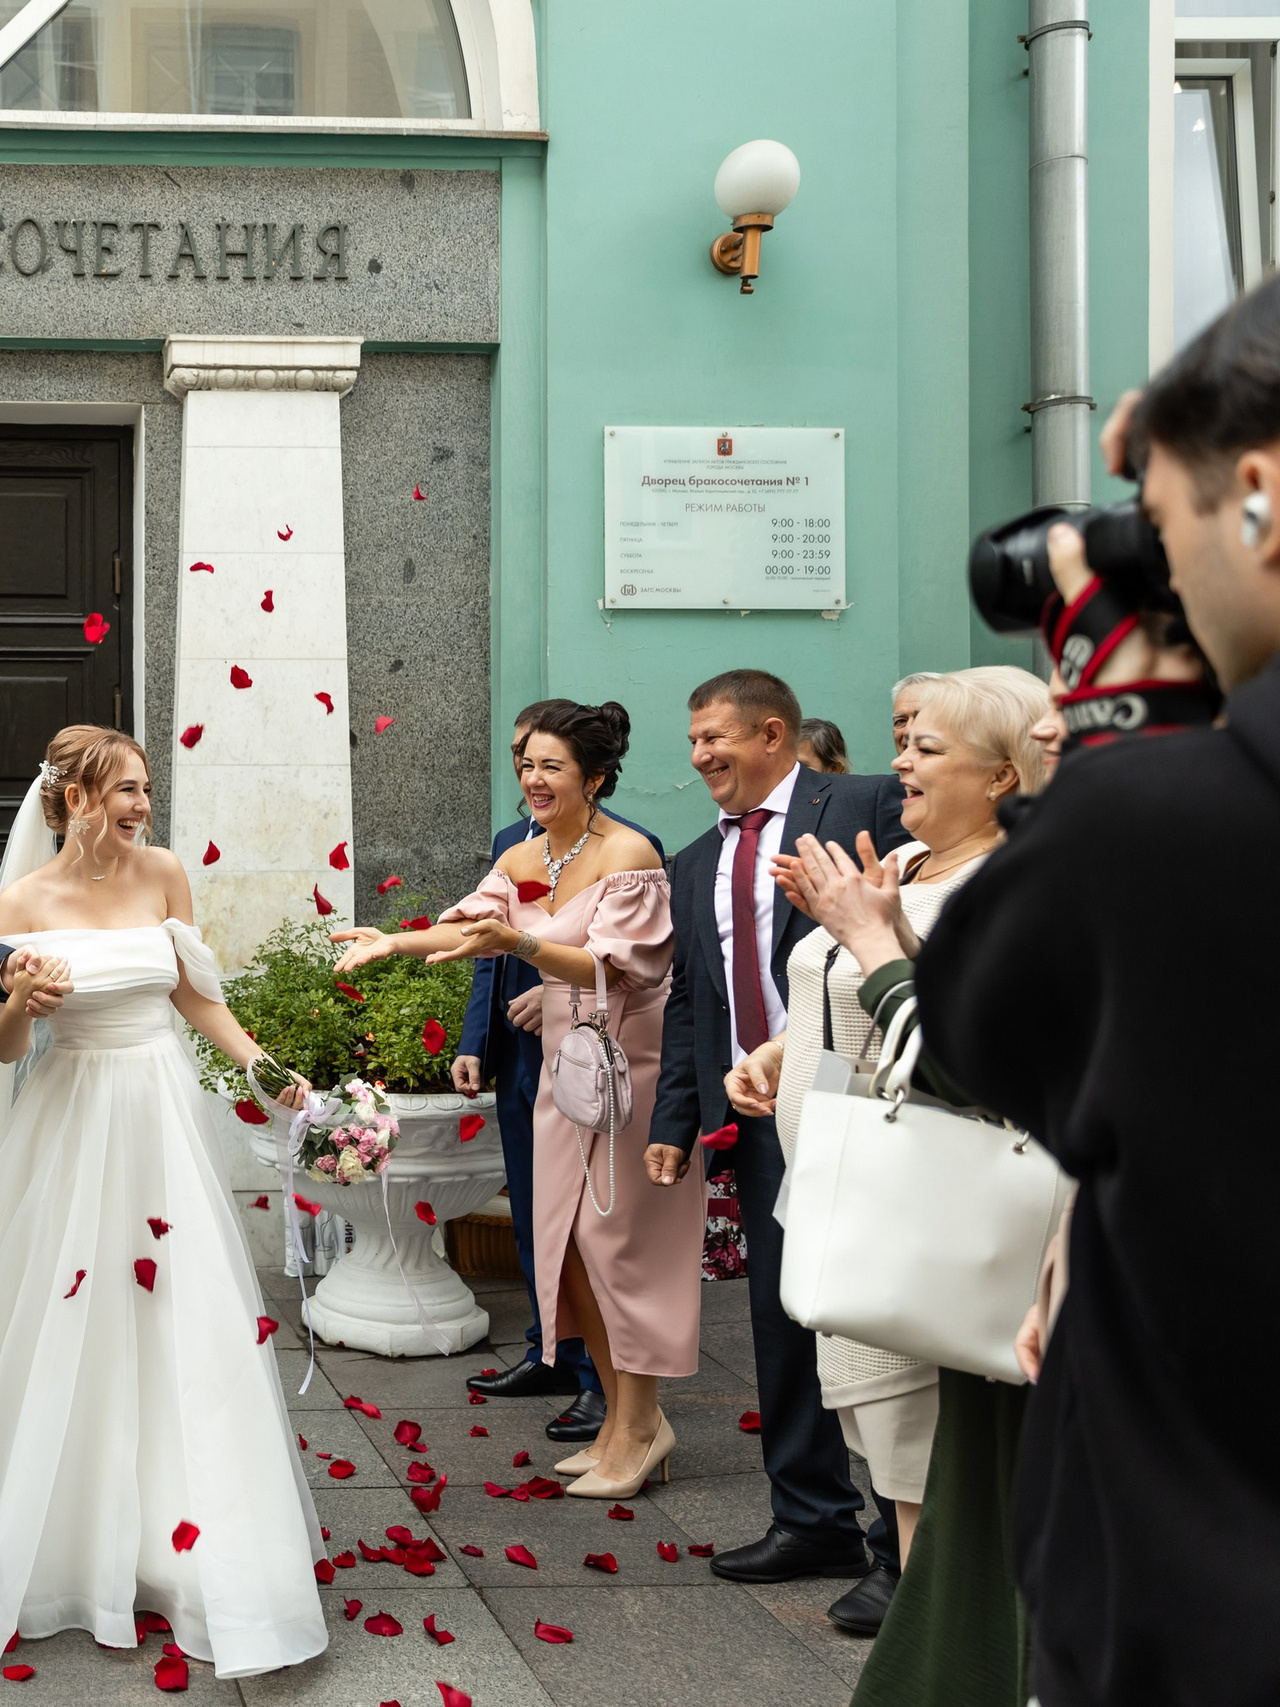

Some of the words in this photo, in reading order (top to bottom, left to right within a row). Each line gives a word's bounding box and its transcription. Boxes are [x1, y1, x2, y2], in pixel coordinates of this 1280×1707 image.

[641, 475, 686, 488] Дворец
[688, 475, 783, 488] бракосочетания
[786, 476, 800, 486] №
[804, 476, 809, 486] 1
[685, 503, 723, 513] РЕЖИМ
[726, 503, 766, 513] РАБОТЫ
[771, 518, 794, 528] 9:00
[804, 518, 831, 528] 18:00
[771, 534, 794, 543] 9:00
[802, 534, 831, 543] 20:00
[771, 549, 794, 559] 9:00
[802, 549, 831, 559] 23:59
[765, 565, 794, 575] 00:00
[804, 565, 831, 575] 19:00
